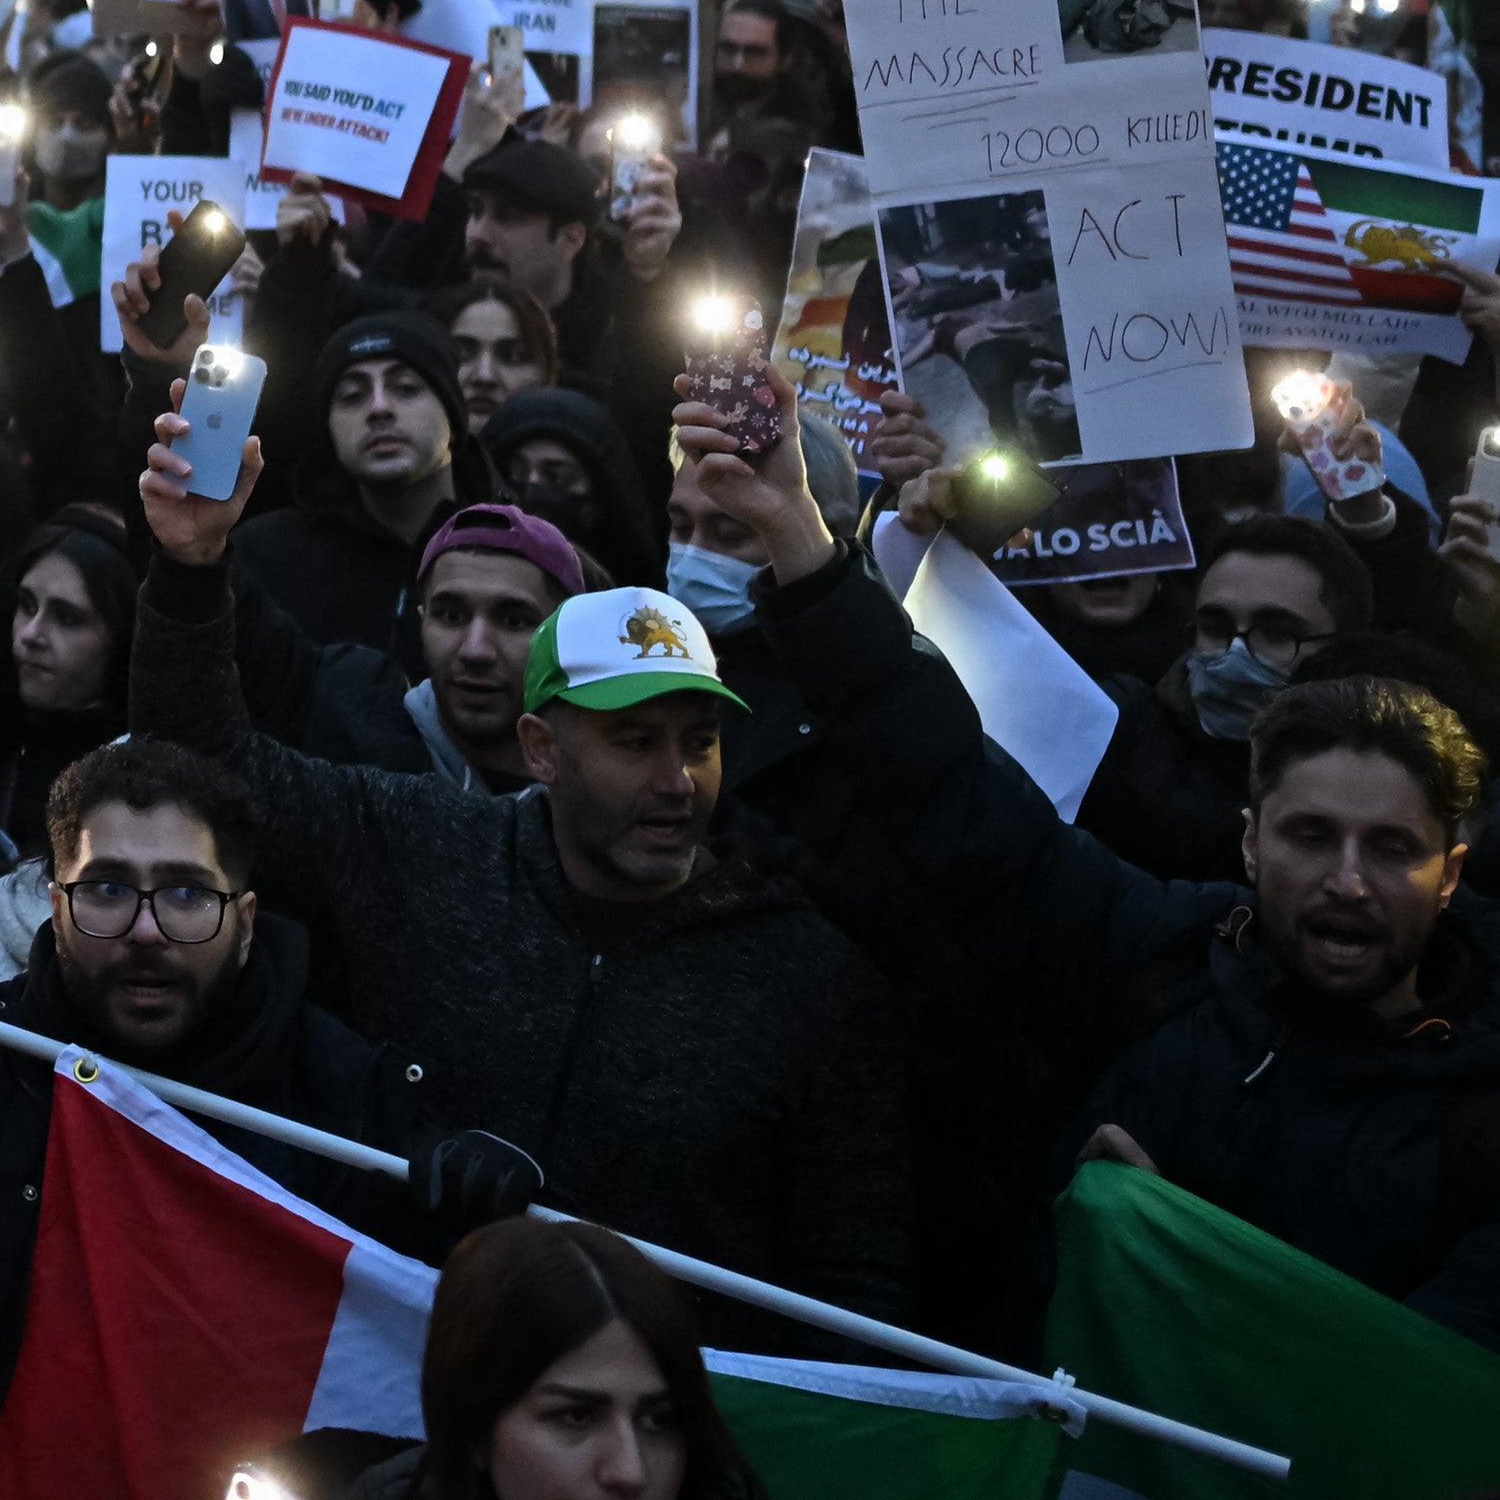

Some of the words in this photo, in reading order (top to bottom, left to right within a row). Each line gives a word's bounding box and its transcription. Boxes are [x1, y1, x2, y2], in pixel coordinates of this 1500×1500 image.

[513, 14, 557, 33] IRAN
[864, 43, 1042, 91] MASSACRE
[302, 82, 332, 102] SAID
[333, 88, 374, 112] YOU'D
[374, 99, 406, 120] ACT
[1204, 56, 1432, 130] RESIDENT
[981, 123, 1101, 173] 12000
[1126, 110, 1210, 149] KILLED!
[140, 180, 204, 201] YOUR
[1068, 194, 1187, 266] ACT
[1083, 306, 1230, 372] NOW!
[1034, 526, 1081, 558] LO
[1087, 508, 1177, 553] SCIÀ
